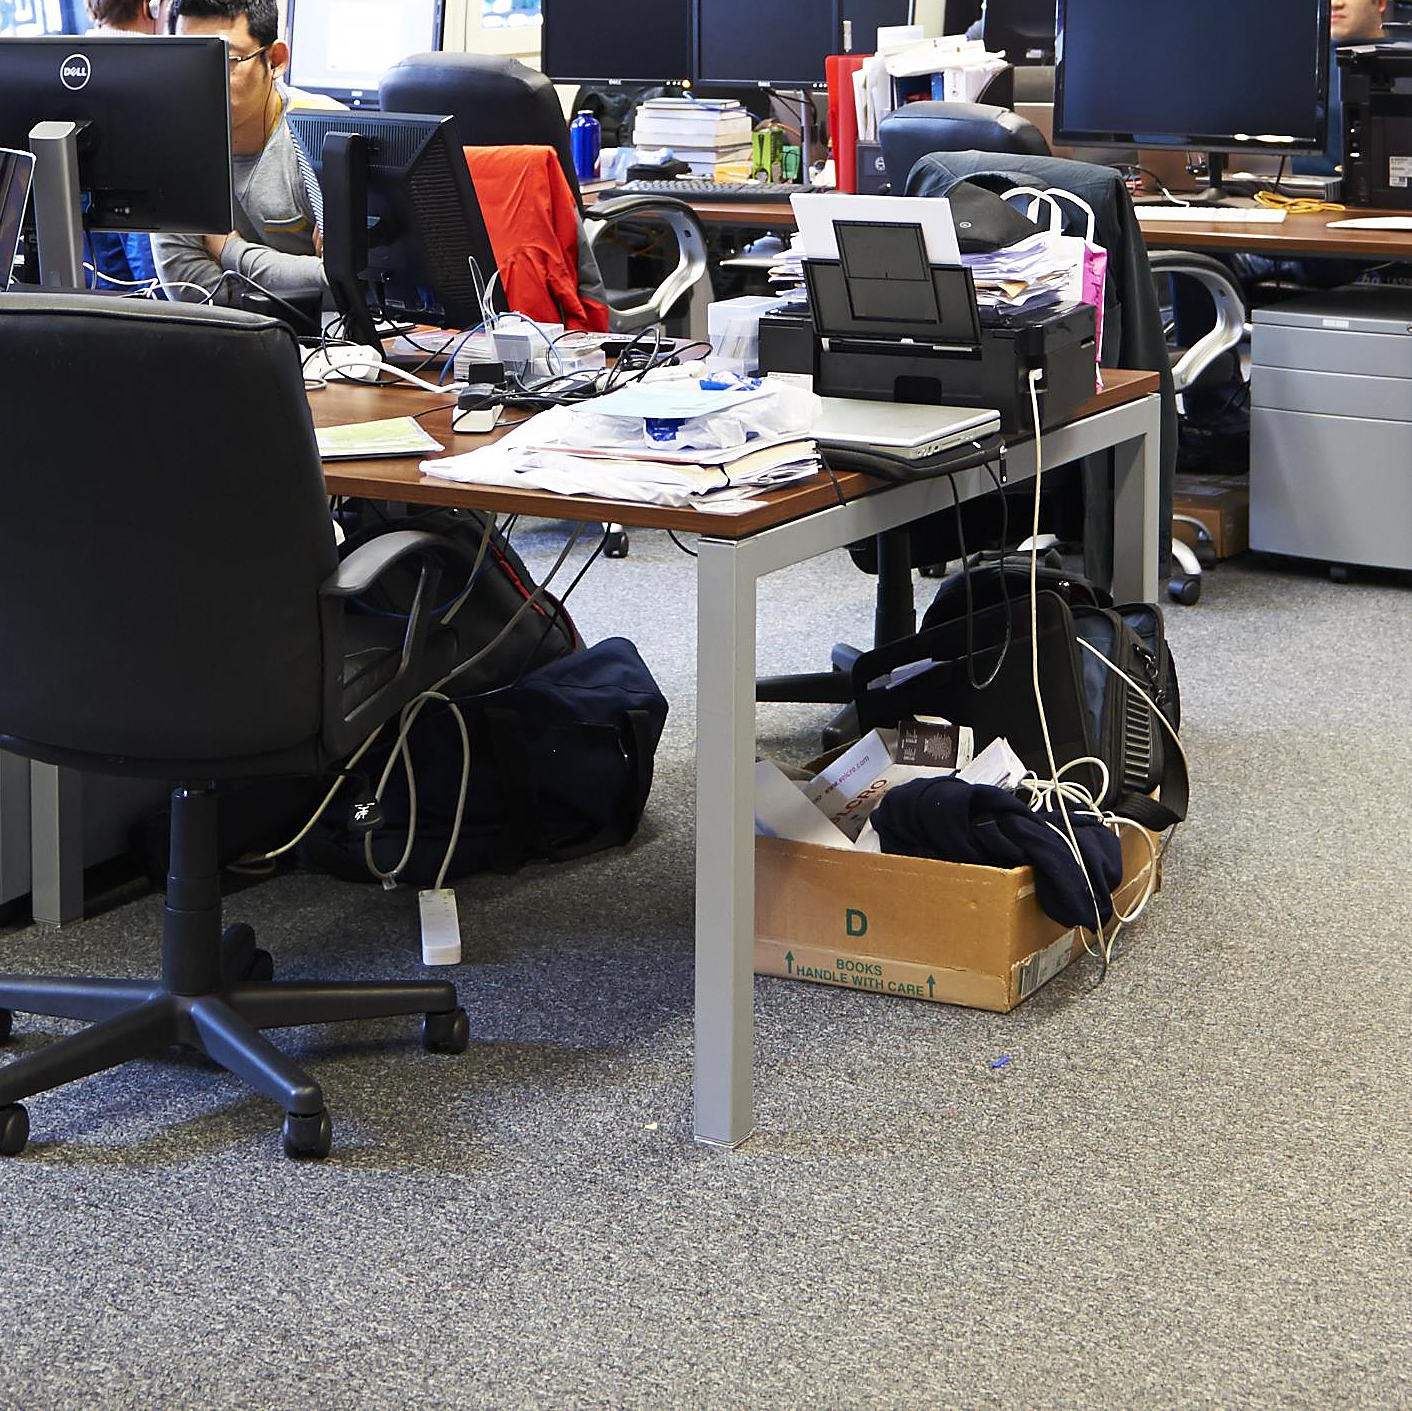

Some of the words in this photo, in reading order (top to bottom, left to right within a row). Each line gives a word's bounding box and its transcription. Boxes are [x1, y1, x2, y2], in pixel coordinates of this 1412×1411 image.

[63, 67, 87, 77] DELL
[845, 908, 869, 937] D
[836, 958, 883, 977] BOOKS
[796, 965, 847, 984] HANDLE
[852, 973, 884, 990] WITH
[888, 980, 925, 997] CARE
